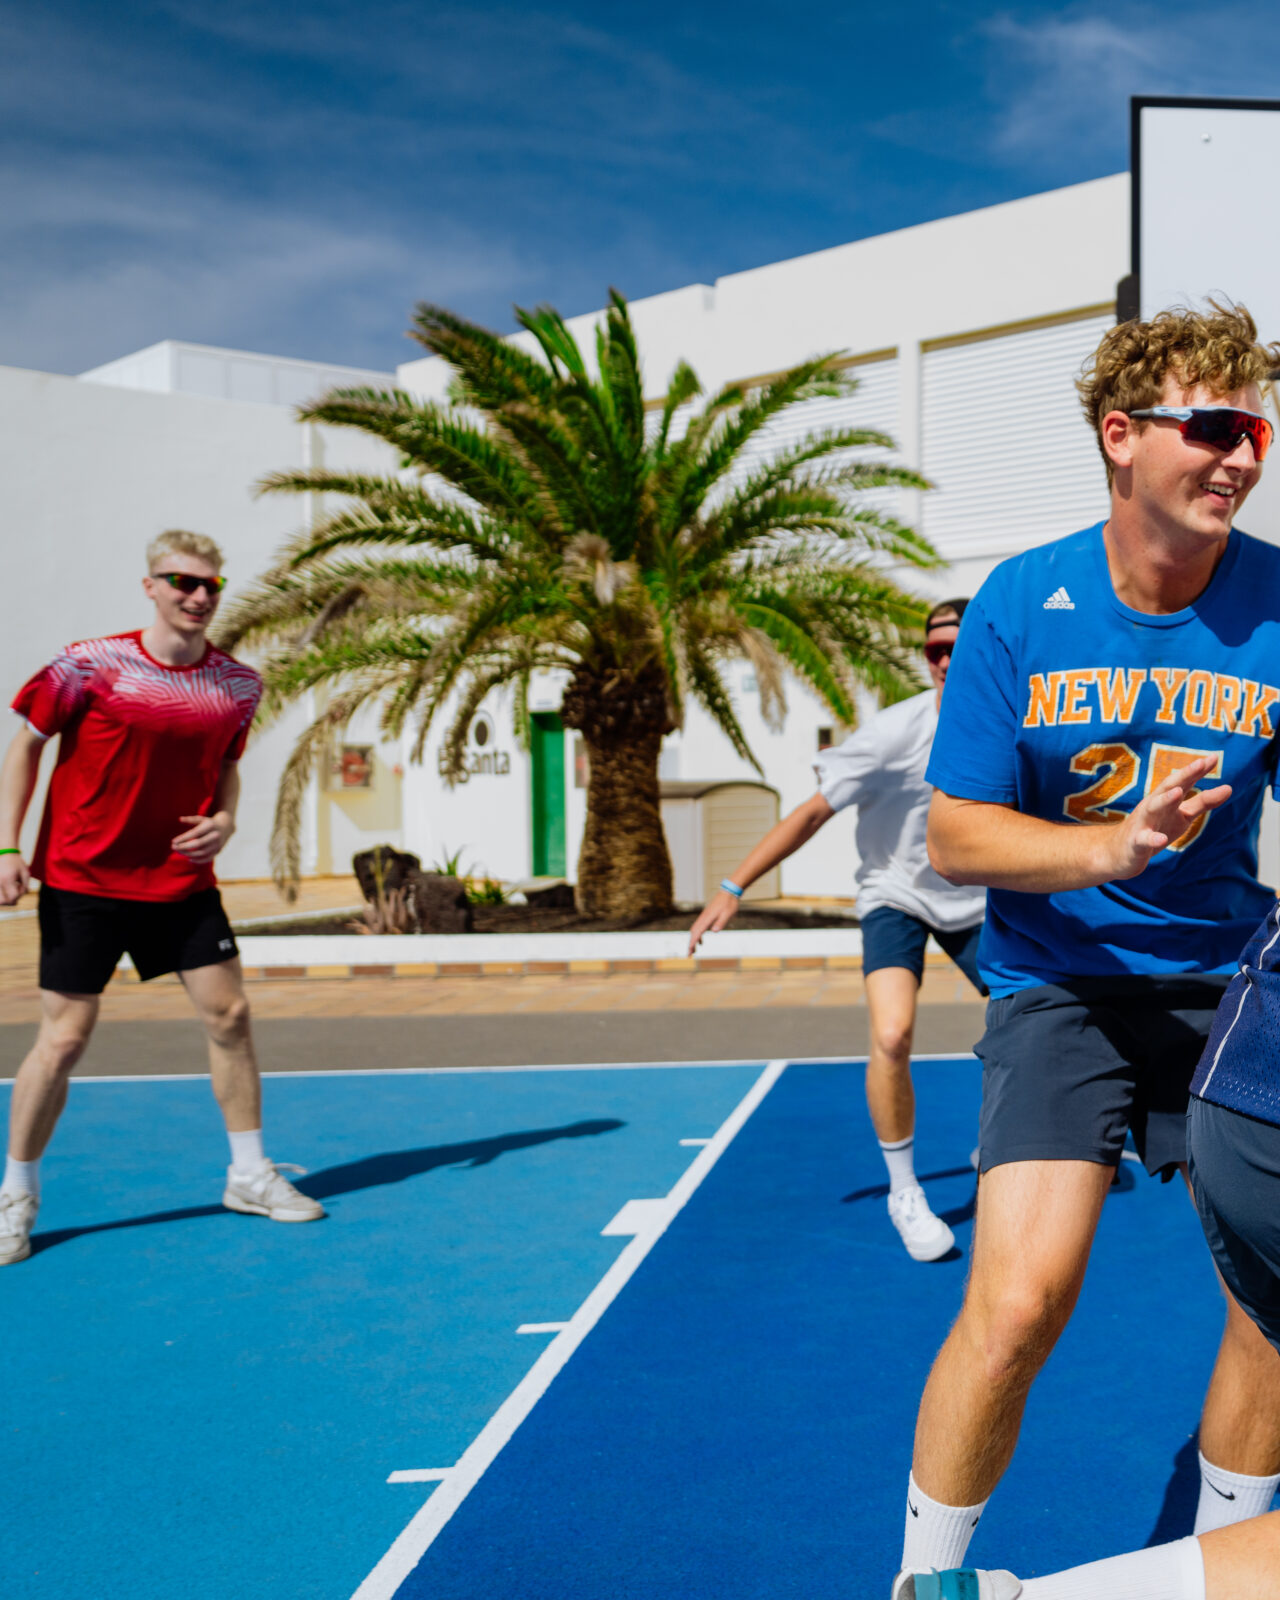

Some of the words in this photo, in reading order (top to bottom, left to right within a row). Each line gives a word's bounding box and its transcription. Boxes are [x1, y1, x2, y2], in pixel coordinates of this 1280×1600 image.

[1043, 600, 1075, 610] adidas
[1022, 667, 1148, 728] NEW
[1063, 742, 1225, 852] 25
